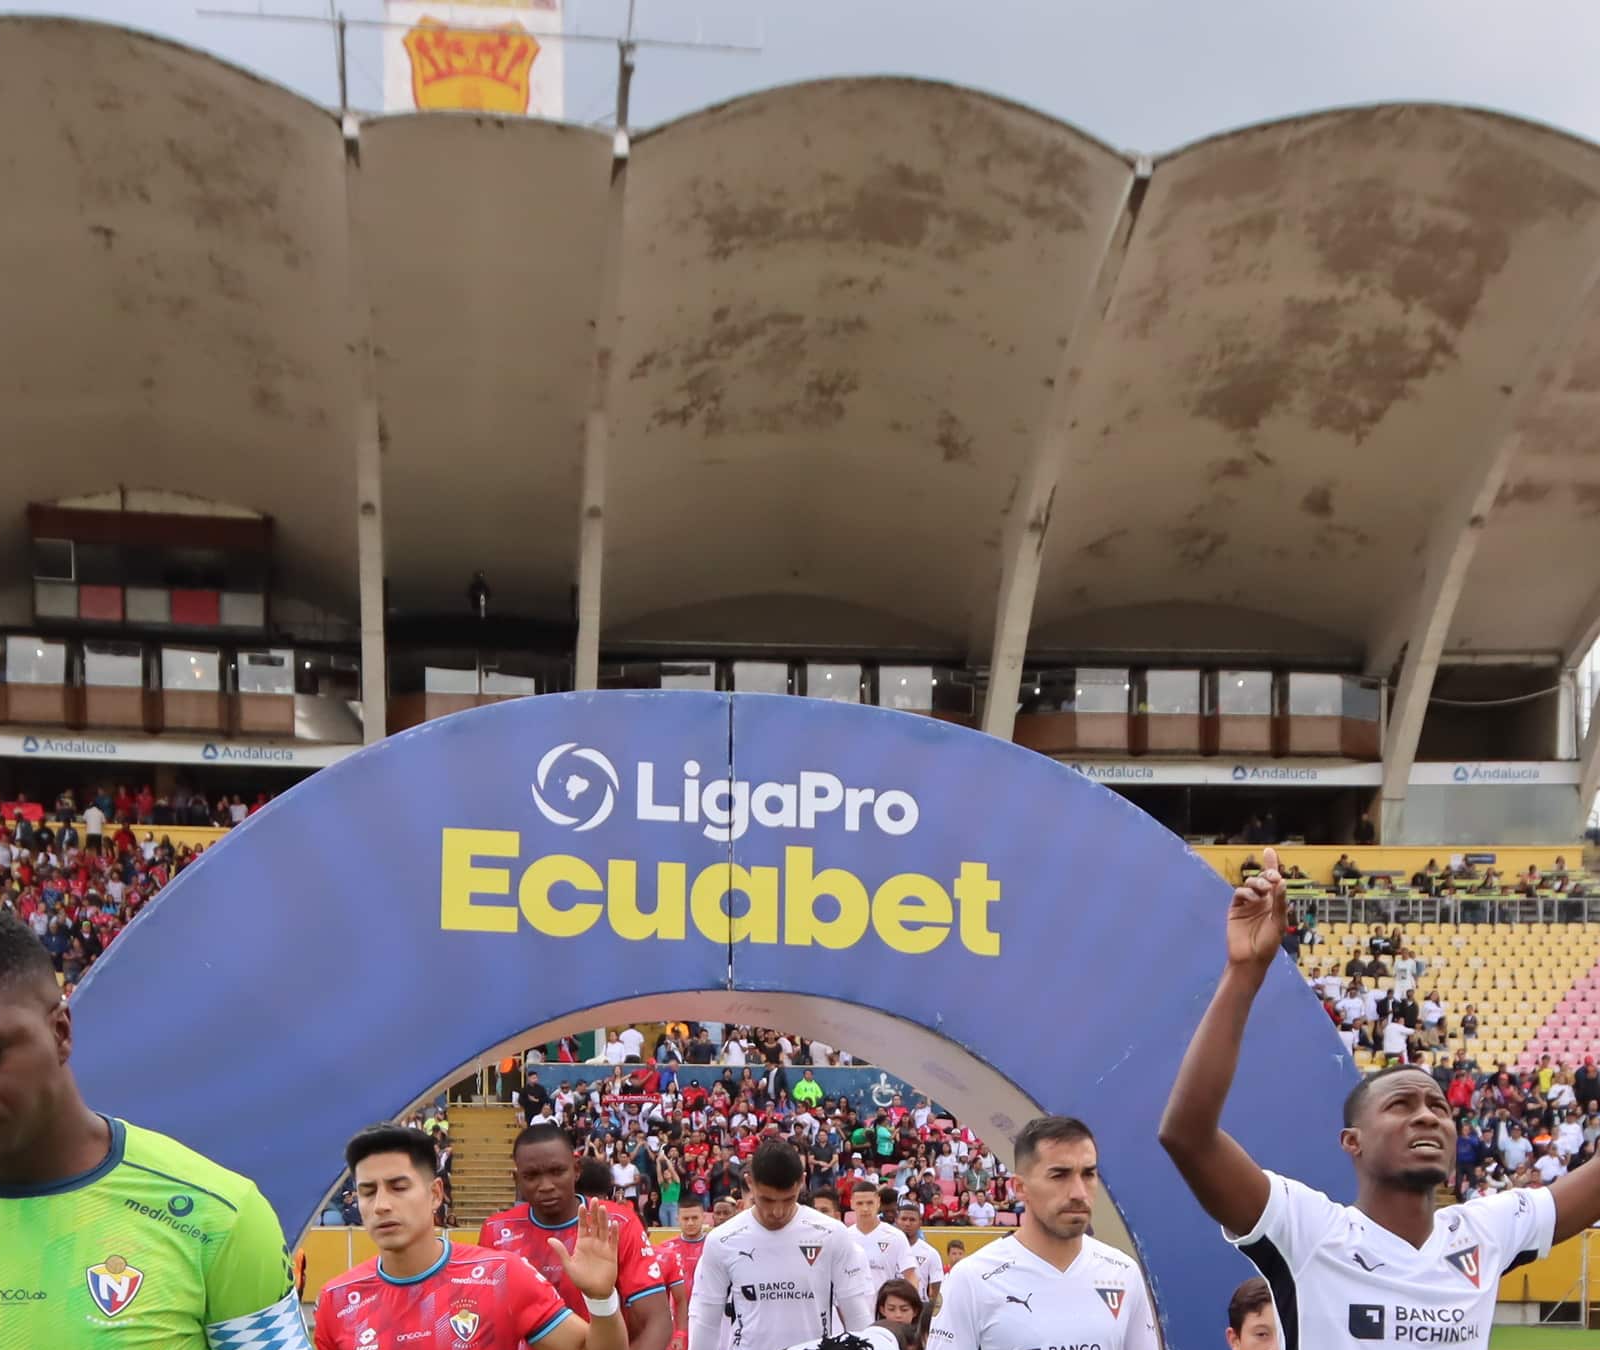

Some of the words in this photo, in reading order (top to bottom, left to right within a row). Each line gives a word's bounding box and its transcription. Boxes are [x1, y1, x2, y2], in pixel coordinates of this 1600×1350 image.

[636, 760, 918, 841] LigaPro
[440, 827, 1000, 956] Ecuabet
[124, 1198, 212, 1246] medinuclear
[1459, 1253, 1478, 1275] U
[99, 1275, 130, 1302] N
[759, 1281, 795, 1291] BANCO
[759, 1291, 815, 1300] PICHINCHA
[1106, 1292, 1119, 1309] U
[1395, 1305, 1465, 1323] BANCO
